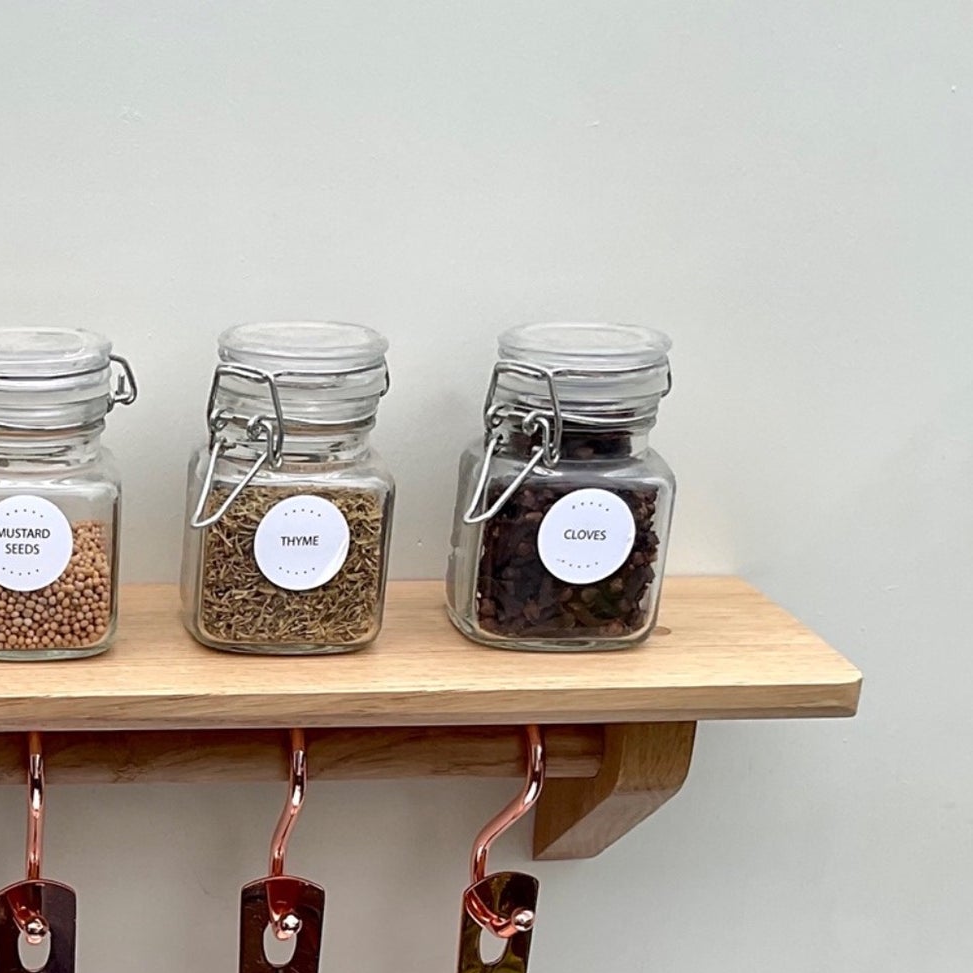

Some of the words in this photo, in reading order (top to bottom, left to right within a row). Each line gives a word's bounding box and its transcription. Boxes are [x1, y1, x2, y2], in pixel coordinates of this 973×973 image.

[563, 528, 607, 541] CLOVES
[280, 535, 319, 547] THYME
[5, 543, 40, 555] SEEDS
